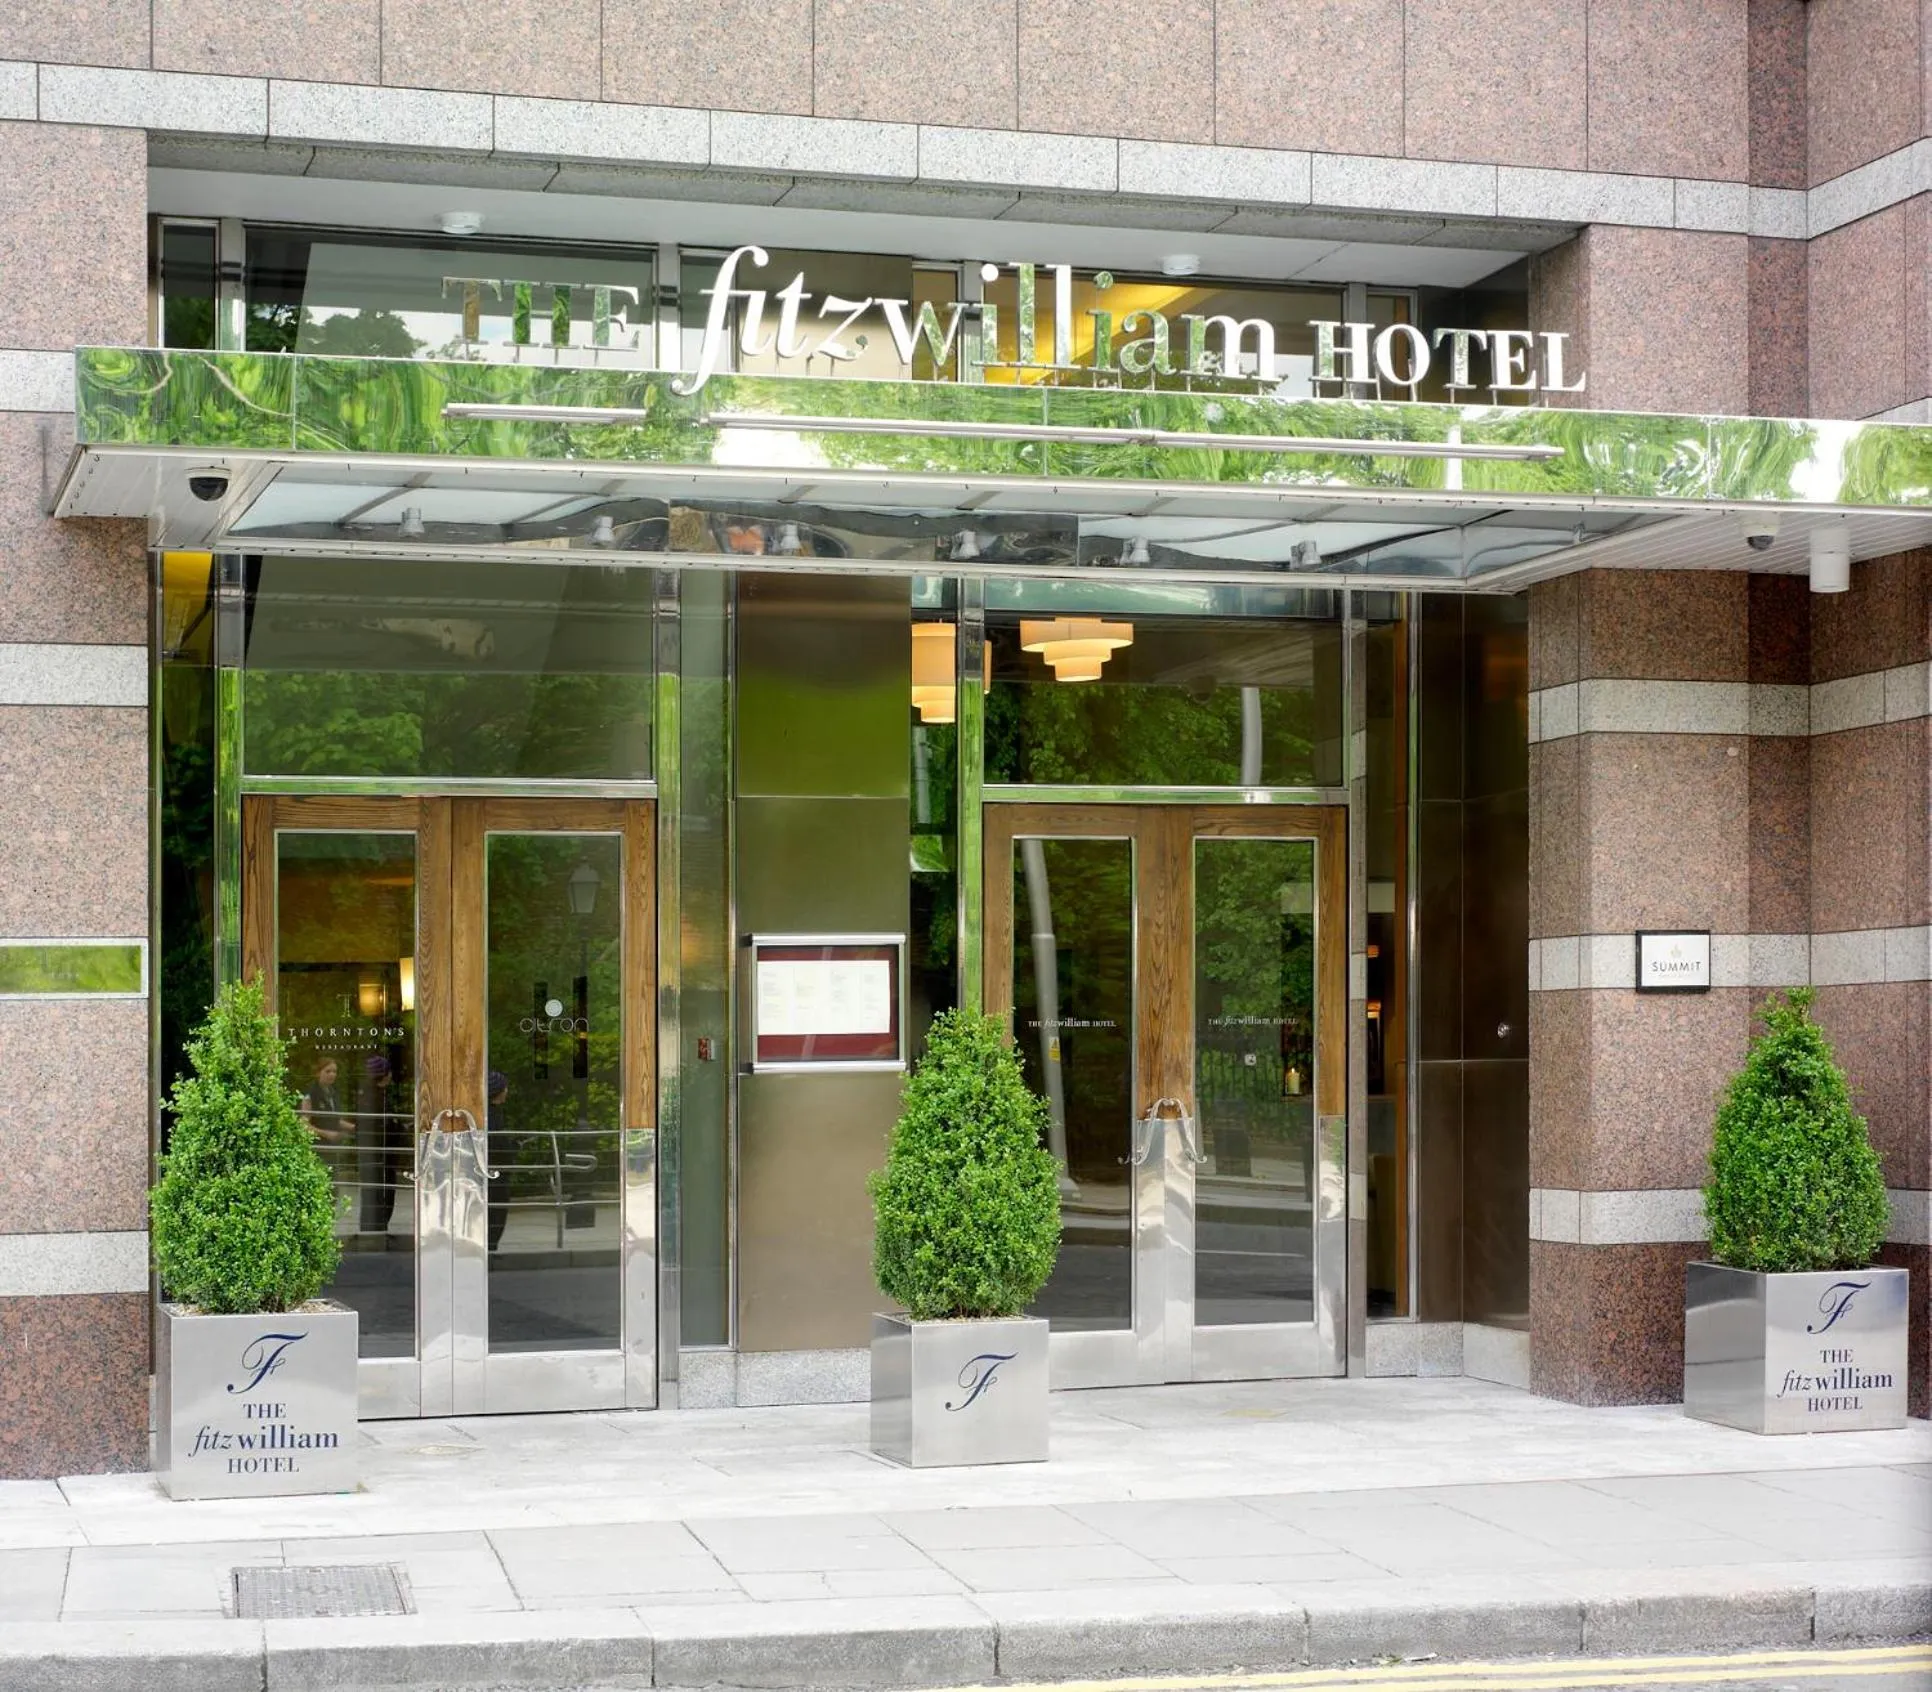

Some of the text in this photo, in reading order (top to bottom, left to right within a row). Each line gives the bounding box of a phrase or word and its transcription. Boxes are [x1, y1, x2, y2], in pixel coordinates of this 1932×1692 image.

[442, 245, 1586, 396] THE fitzwilliam HOTEL
[1651, 961, 1702, 972] SUMMIT
[288, 1027, 405, 1037] THORNTON'S
[1820, 1349, 1853, 1364] THE
[1776, 1367, 1893, 1398] fitzwilliam
[243, 1403, 287, 1419] THE
[1808, 1396, 1863, 1412] HOTEL
[187, 1424, 339, 1457] fitzwilliam
[227, 1457, 300, 1474] HOTEL
